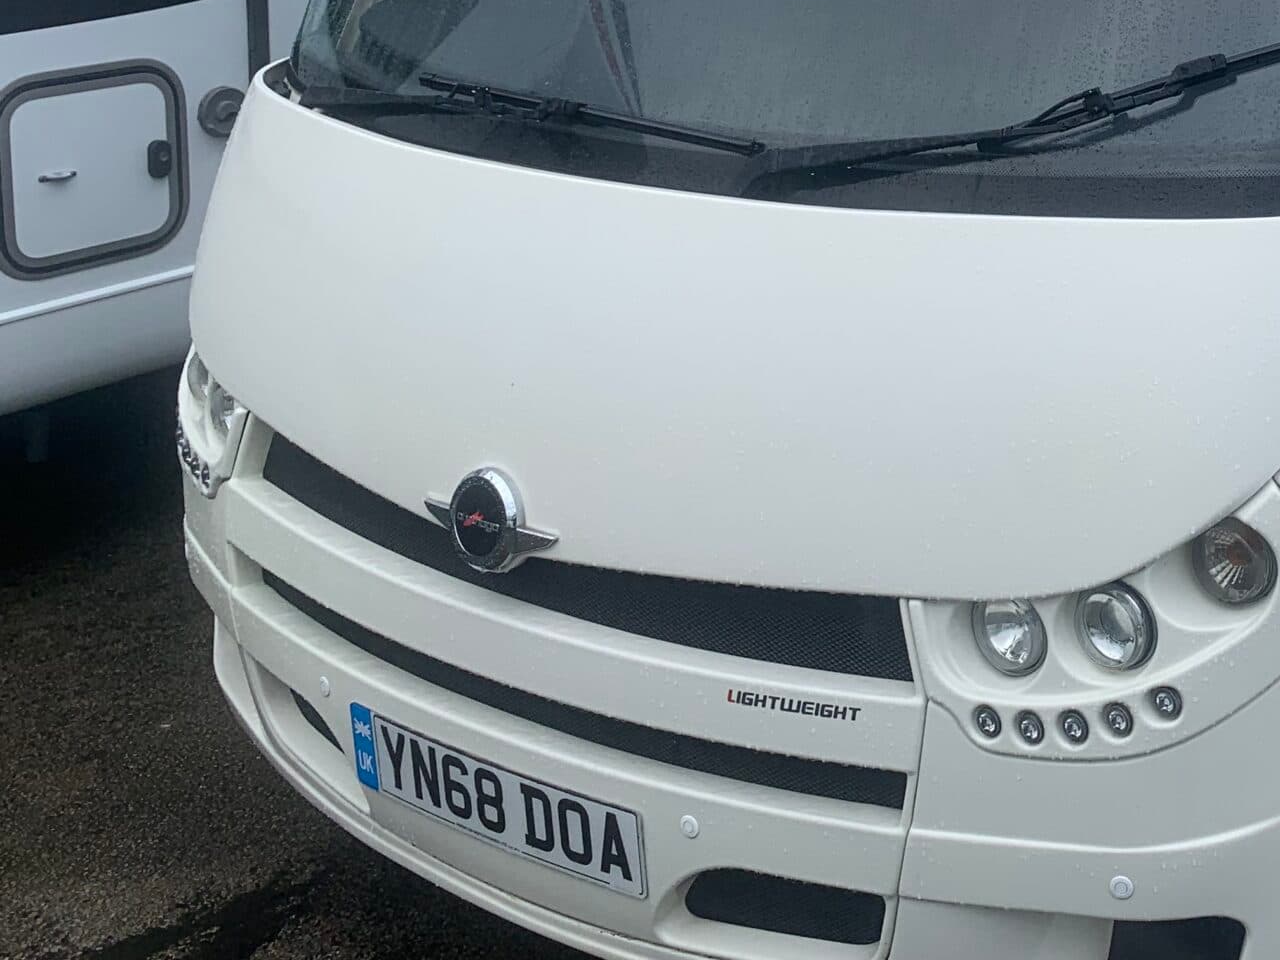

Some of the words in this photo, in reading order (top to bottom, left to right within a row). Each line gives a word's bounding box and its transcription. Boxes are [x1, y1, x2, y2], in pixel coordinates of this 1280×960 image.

[727, 689, 861, 721] LIGHTWEIGHT
[358, 753, 374, 775] UK
[381, 724, 506, 834] YN68
[520, 782, 633, 882] DOA
